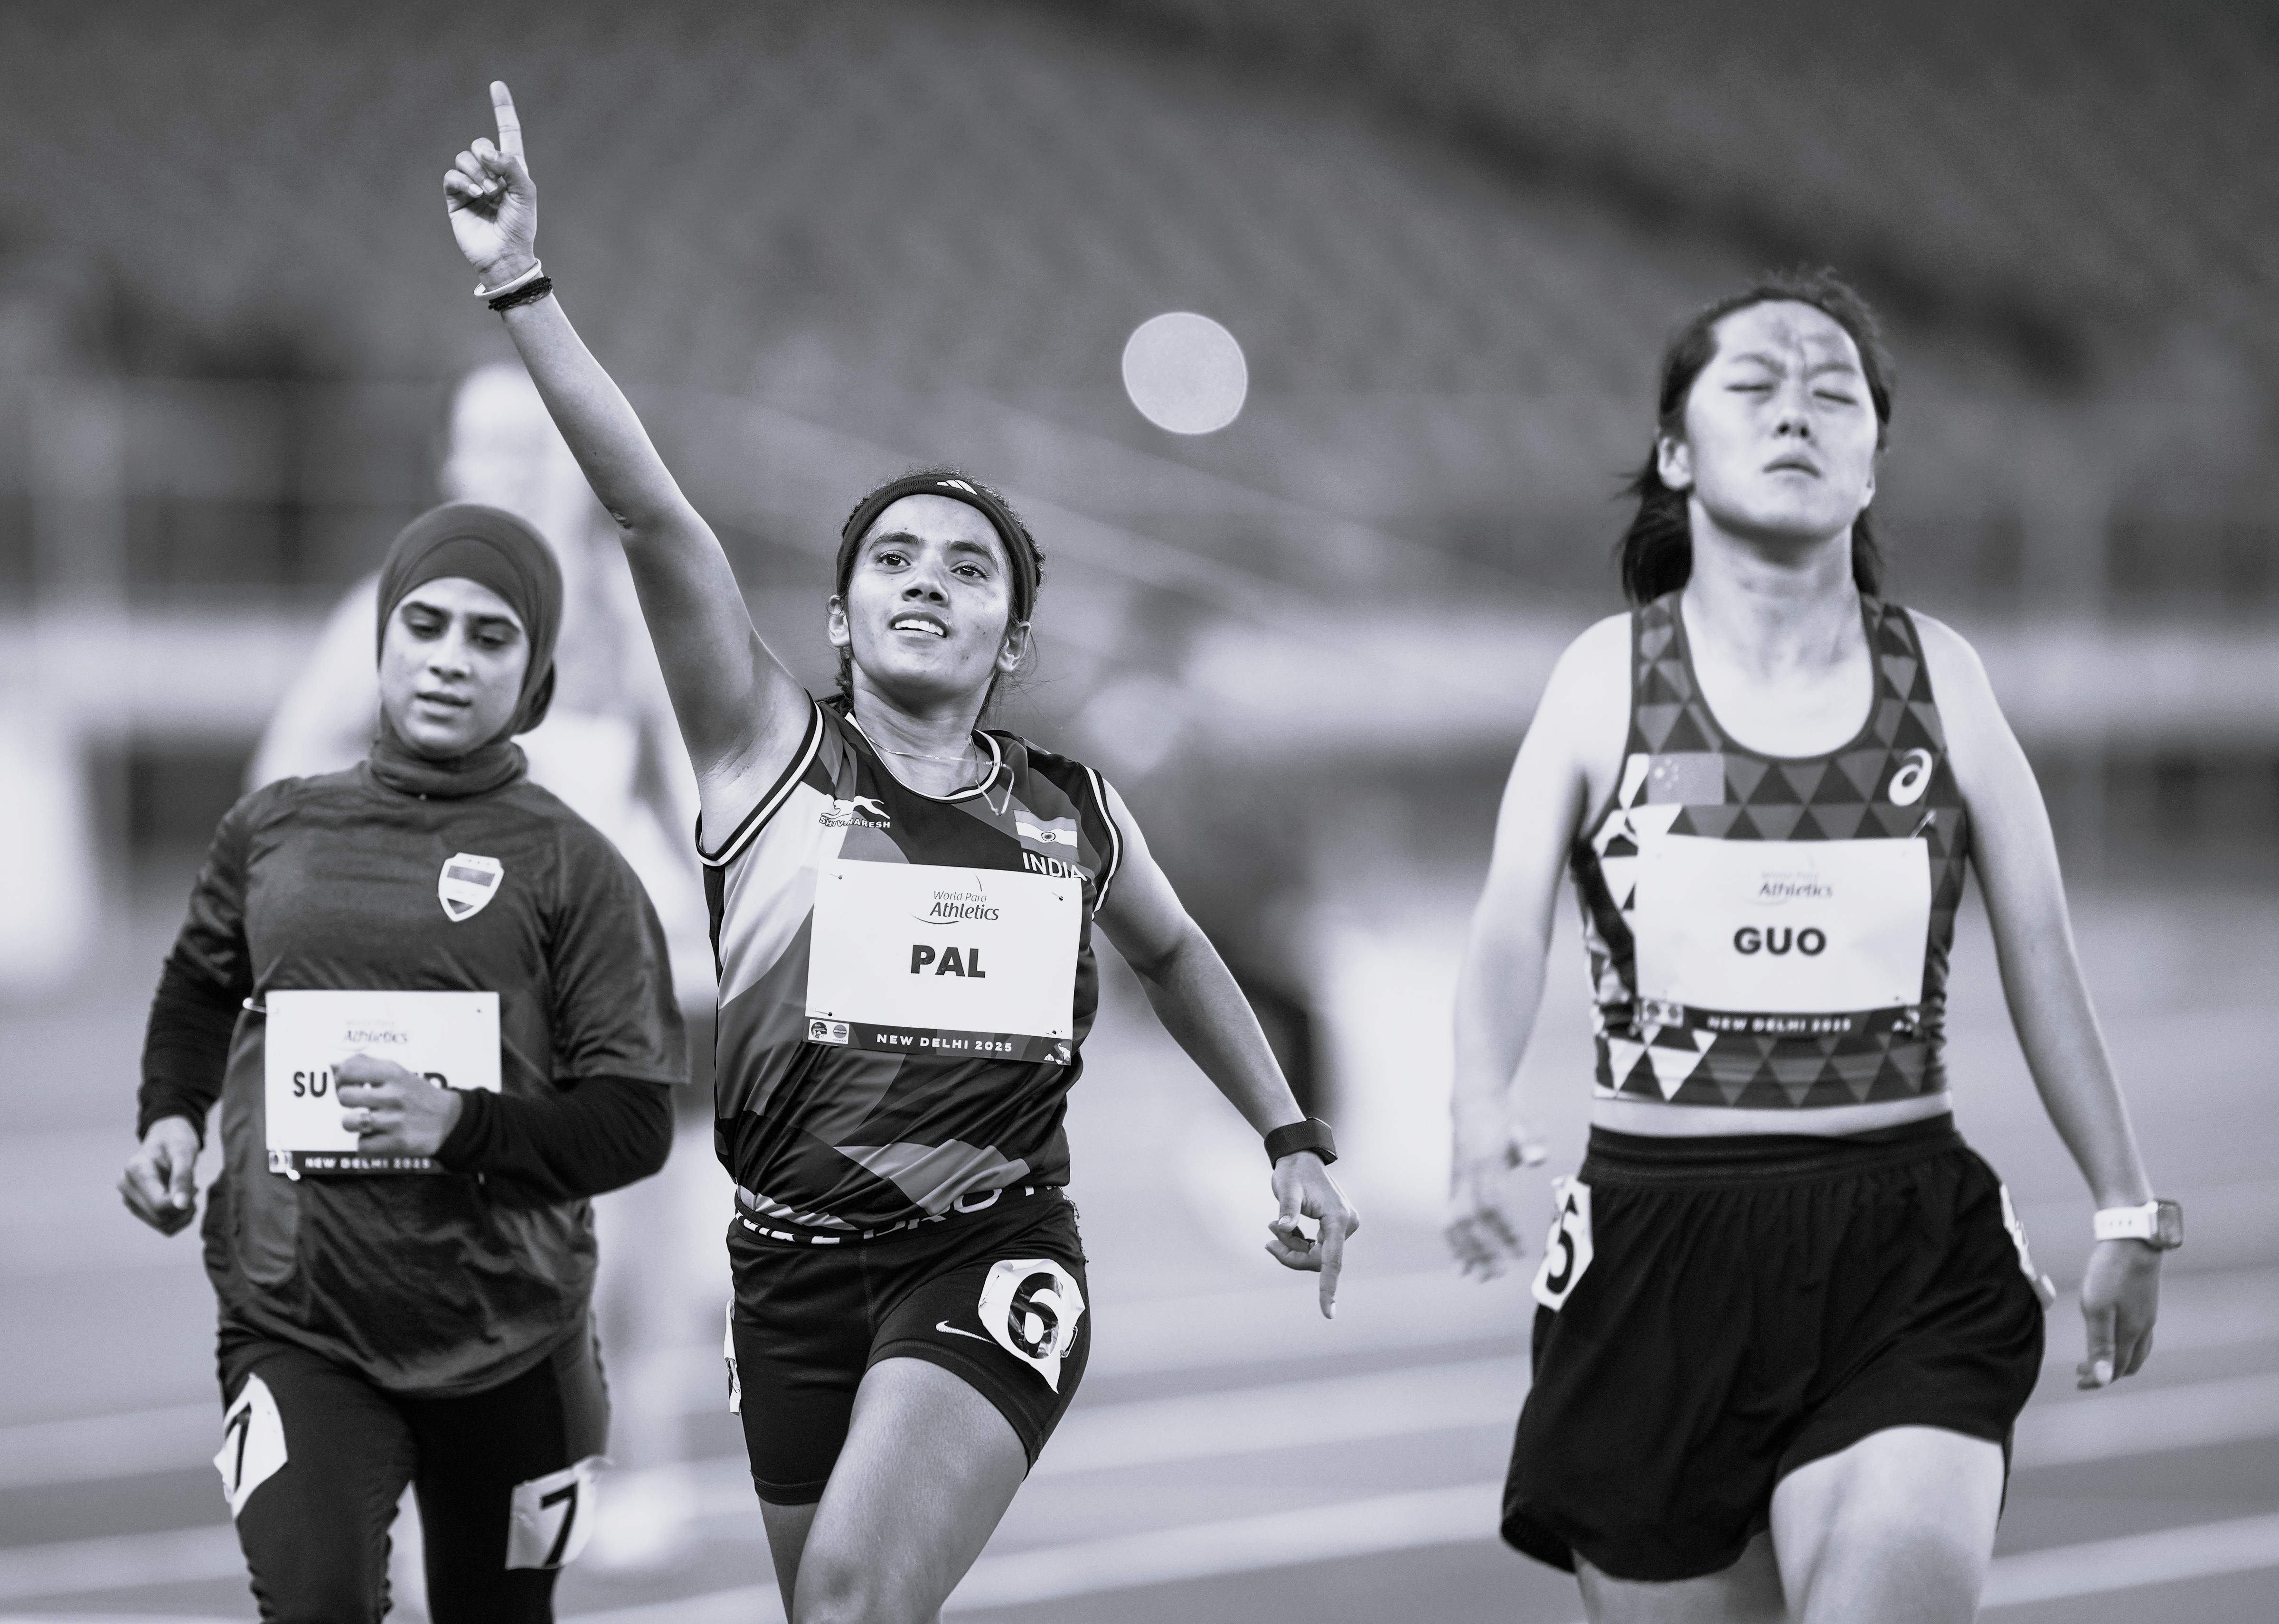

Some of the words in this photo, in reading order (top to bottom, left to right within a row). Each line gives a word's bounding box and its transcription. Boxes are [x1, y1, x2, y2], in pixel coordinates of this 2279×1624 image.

[819, 816, 890, 828] SHIV-NARESH
[1022, 852, 1087, 881] INDIA
[934, 891, 963, 901] World
[965, 892, 987, 902] Para
[930, 902, 999, 920] Athletics
[1733, 926, 1827, 956] GUO
[910, 944, 986, 978] PAL
[877, 1034, 913, 1045] NEW
[920, 1037, 968, 1049] DELHI
[975, 1041, 1012, 1052] 2025
[305, 1157, 336, 1169] NEW
[340, 1157, 389, 1169] DELHI
[1008, 1272, 1063, 1359] 6
[541, 1480, 579, 1566] 7
